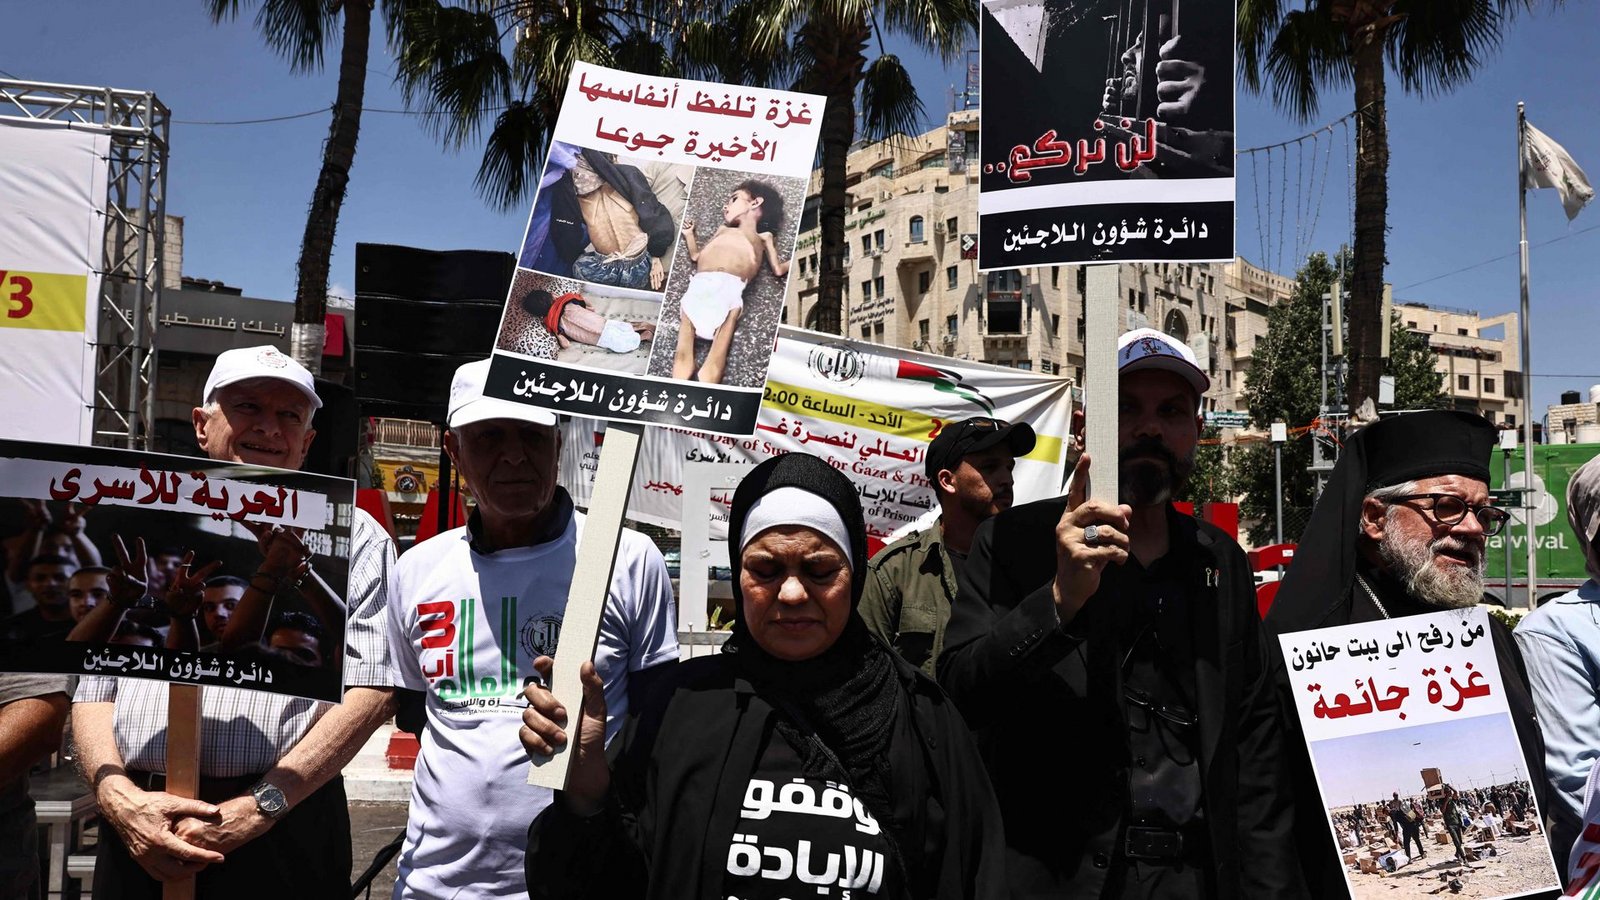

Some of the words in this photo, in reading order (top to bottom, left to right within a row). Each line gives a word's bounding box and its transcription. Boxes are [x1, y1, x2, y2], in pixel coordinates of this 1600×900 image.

[578, 72, 680, 109] أنفاسها
[687, 91, 756, 119] تلفظ
[765, 98, 813, 129] غزة
[595, 117, 675, 155] جوعا
[684, 131, 777, 162] الأخيرة
[1115, 118, 1157, 171] لن
[1003, 222, 1085, 252] اللاجئين
[1092, 217, 1148, 246] شؤون
[1153, 216, 1209, 244] دائرة
[160, 312, 236, 329] فلسطي
[242, 320, 285, 338] بنك
[513, 370, 604, 404] اللاجئين
[608, 387, 668, 415] شؤون
[673, 393, 733, 421] دائرة
[802, 396, 856, 418] الساعة
[868, 412, 903, 429] الأحد
[793, 420, 857, 450] لنصرة
[743, 439, 760, 451] of
[827, 455, 848, 471] for
[852, 462, 888, 479] Gaza
[892, 470, 905, 483] &
[859, 438, 925, 463] العالمي
[50, 460, 183, 506] للأسرى
[190, 470, 299, 522] الحرية
[868, 506, 881, 516] of
[883, 508, 920, 522] Prison
[417, 601, 456, 650] 3
[1418, 623, 1453, 653] رفح
[1460, 620, 1485, 647] من
[83, 648, 164, 672] اللاجئين
[169, 656, 221, 680] شؤون
[1292, 641, 1341, 671] حانون
[225, 659, 273, 684] دائرة
[1421, 661, 1491, 712] غزة
[1307, 676, 1410, 721] جائعة
[727, 833, 885, 900] الإبادة
